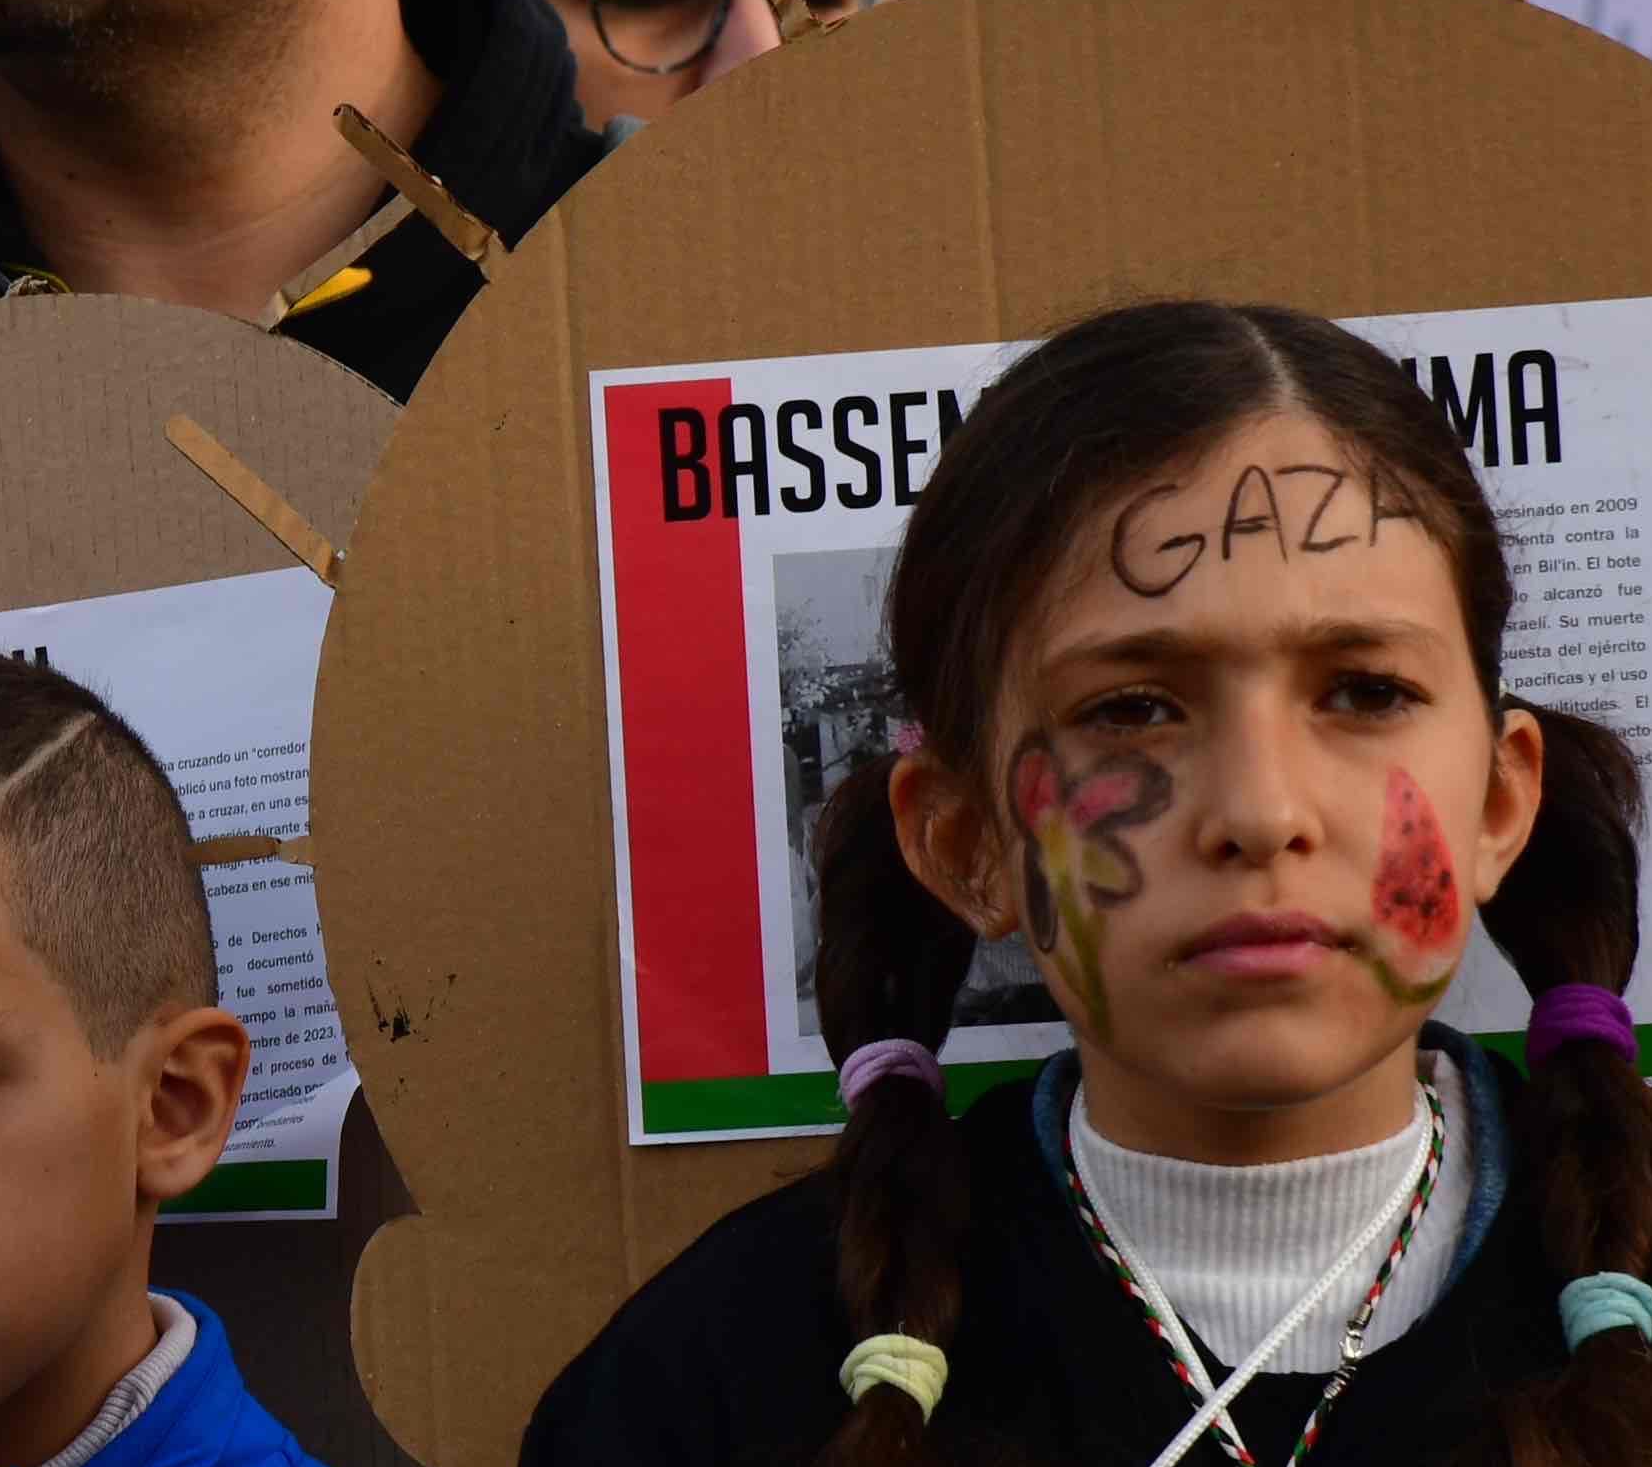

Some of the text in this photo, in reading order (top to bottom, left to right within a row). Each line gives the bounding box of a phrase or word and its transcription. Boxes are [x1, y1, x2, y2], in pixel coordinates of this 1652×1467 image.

[1401, 349, 1562, 468] MA
[1495, 497, 1638, 520] sesinado en 2009
[1565, 529, 1615, 544] contra
[1625, 526, 1640, 540] la
[1513, 563, 1532, 575] en
[1606, 555, 1642, 570] bote
[1543, 584, 1603, 602] alcanzó
[1617, 582, 1643, 597] fue
[1504, 612, 1645, 633] sraelí. Su muerte
[1557, 642, 1582, 657] del
[1588, 638, 1647, 657] ejército
[1514, 671, 1584, 691] pacíficas
[1601, 670, 1616, 683] el
[1619, 667, 1648, 681] uso
[177, 751, 231, 772] cruzando
[234, 749, 249, 762] un
[209, 779, 231, 793] una
[234, 773, 258, 789] foto
[251, 801, 266, 813] en
[269, 796, 291, 810] una
[206, 882, 249, 898] cabeza
[252, 880, 267, 892] en
[270, 877, 291, 889] ese
[227, 933, 243, 948] de
[251, 926, 307, 945] Derechos
[247, 950, 314, 971] documentó
[236, 985, 256, 999] fue
[266, 976, 323, 995] sometido
[283, 1005, 296, 1018] la
[249, 1035, 281, 1050] mbre
[284, 1032, 301, 1045] de
[251, 1052, 338, 1077] el proceso de
[239, 1083, 302, 1106] practicado
